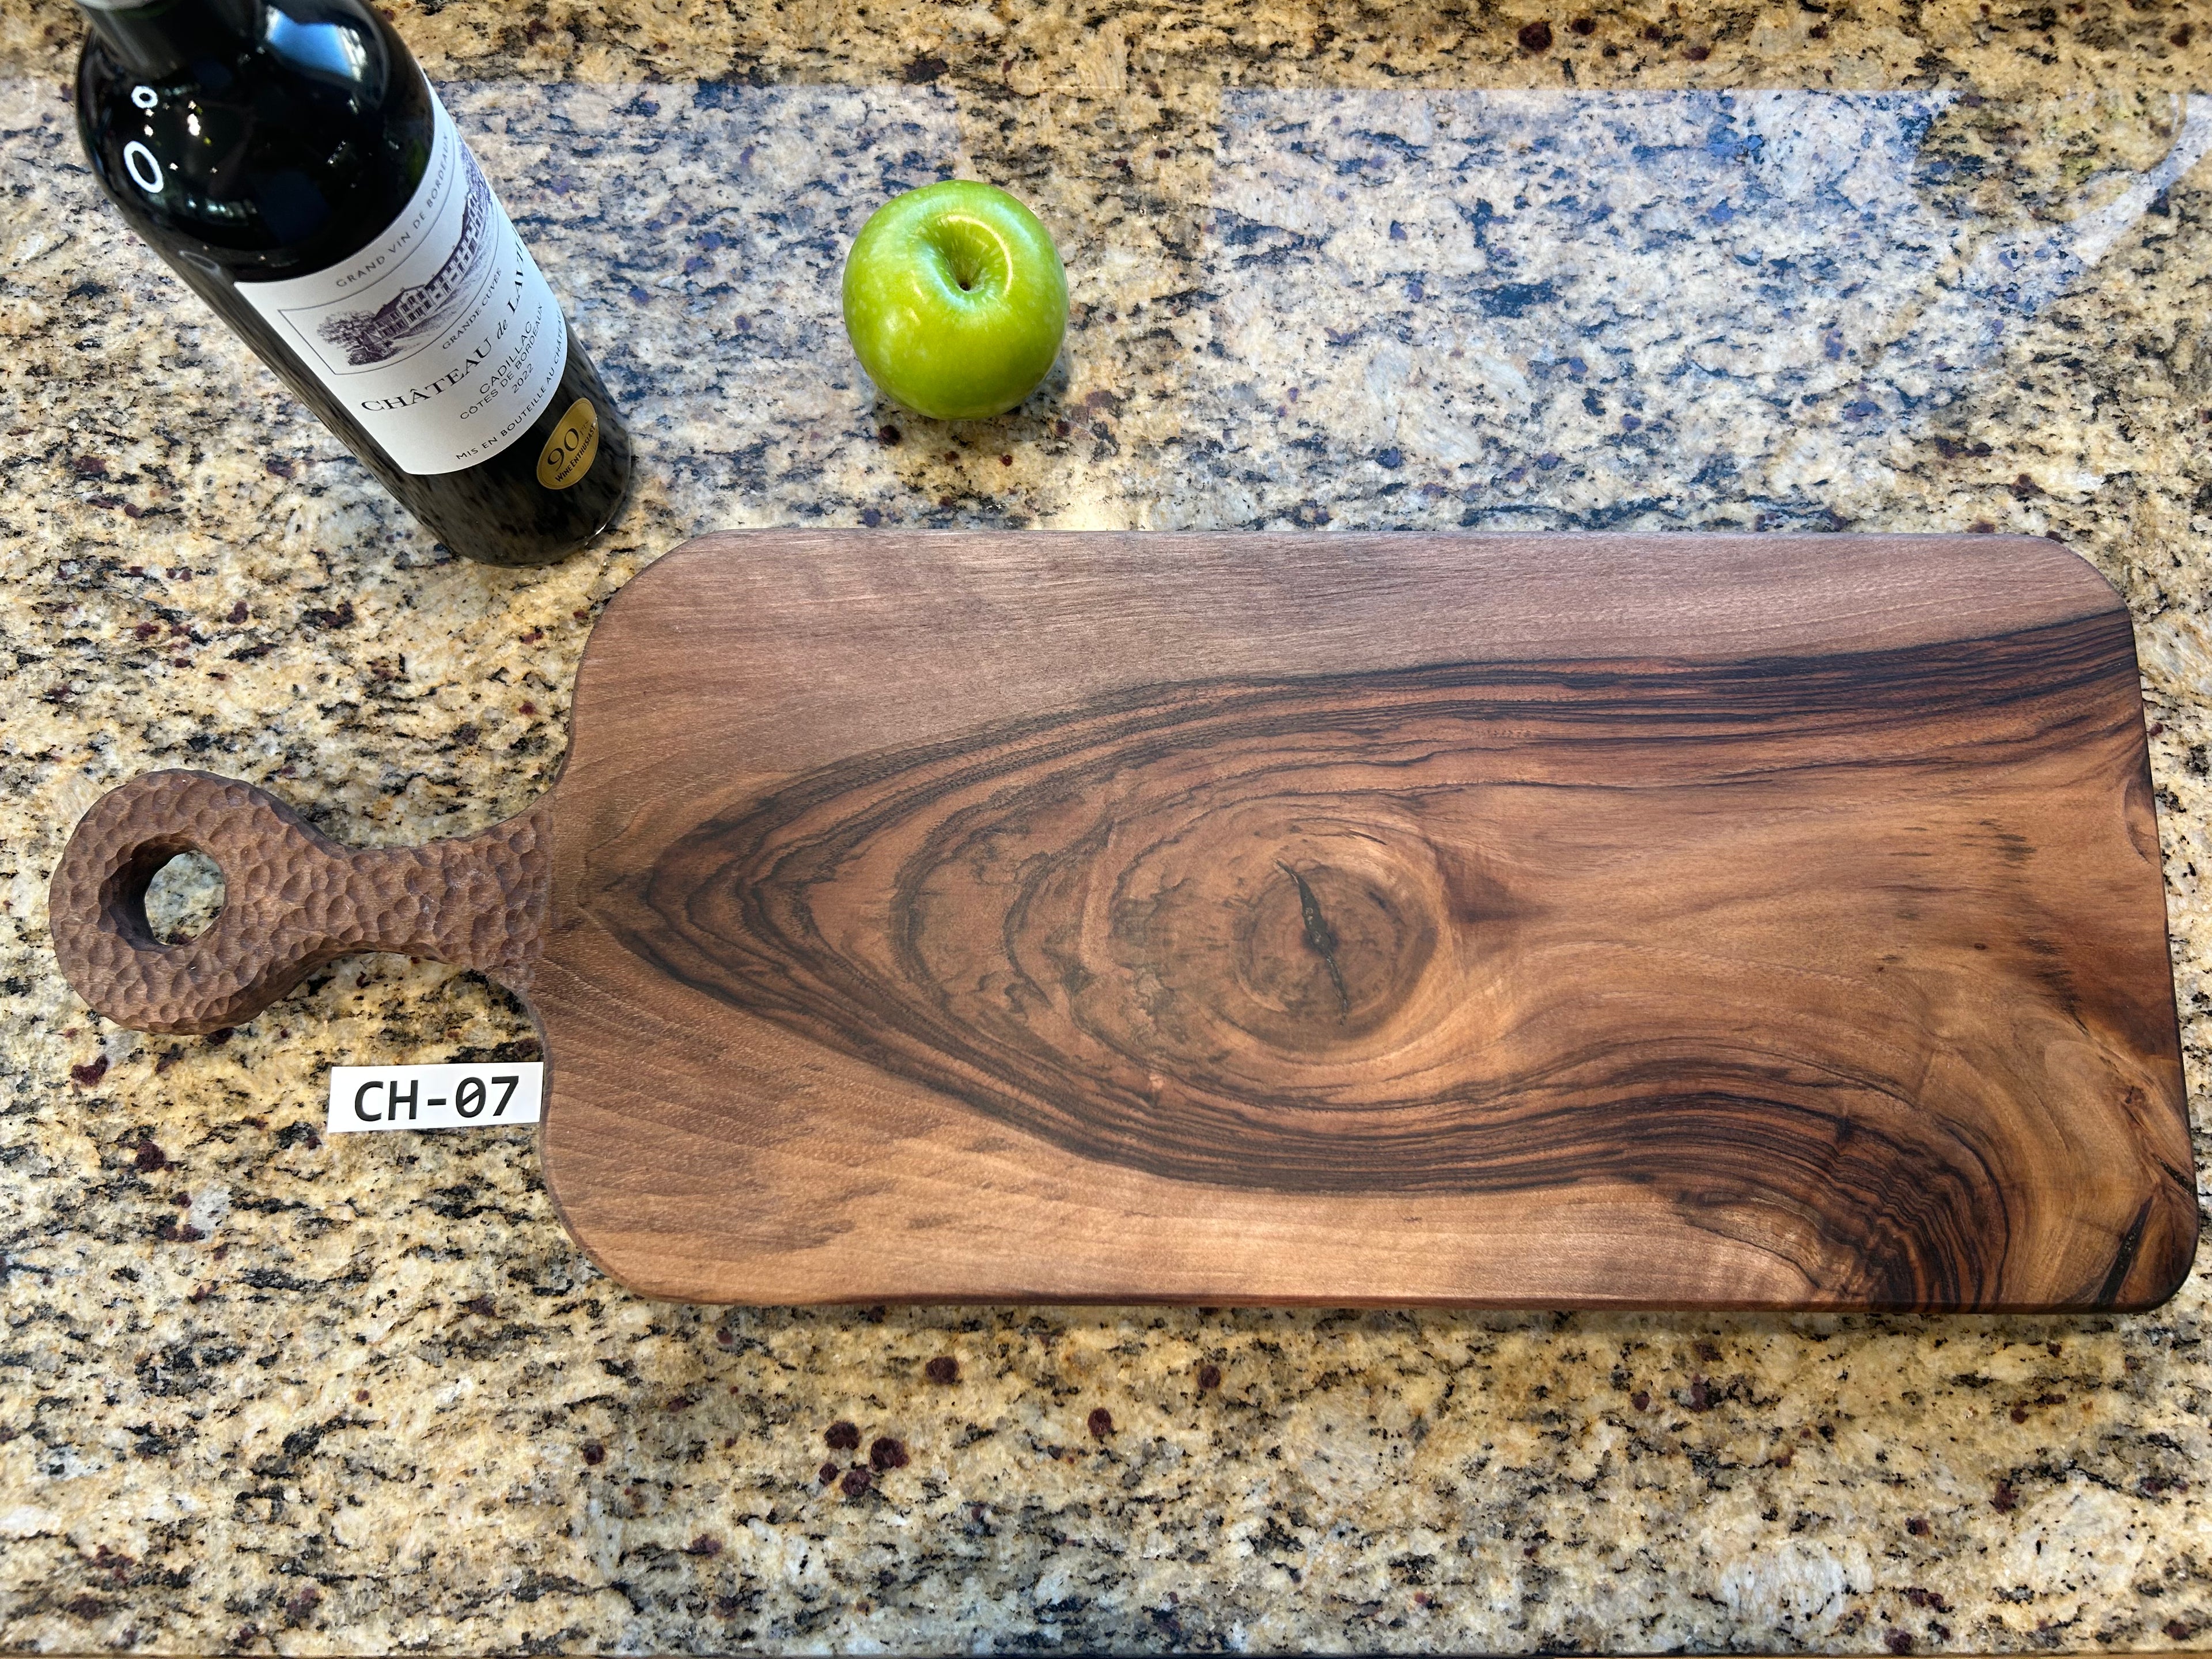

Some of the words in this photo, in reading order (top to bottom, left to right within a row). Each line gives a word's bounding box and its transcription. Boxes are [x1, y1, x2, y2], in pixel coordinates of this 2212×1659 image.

[336, 255, 385, 287] GRAND
[388, 232, 411, 254] VIN
[413, 211, 426, 229] DE
[426, 132, 448, 207] BORDEAUX
[361, 337, 492, 411] CHÂTEAU
[497, 319, 508, 340] de
[442, 307, 482, 350] GRANDE
[460, 389, 498, 419] CÔTES
[500, 370, 515, 387] DE
[515, 302, 543, 370] BORDEAUX
[480, 321, 532, 394] CADILLAC
[456, 448, 478, 460] MIS
[482, 437, 498, 449] EN
[501, 385, 546, 437] BOUTEILLE
[547, 367, 555, 384] AU
[512, 363, 533, 393] 2022
[548, 428, 579, 471] 90
[354, 1075, 519, 1122] CH-07
